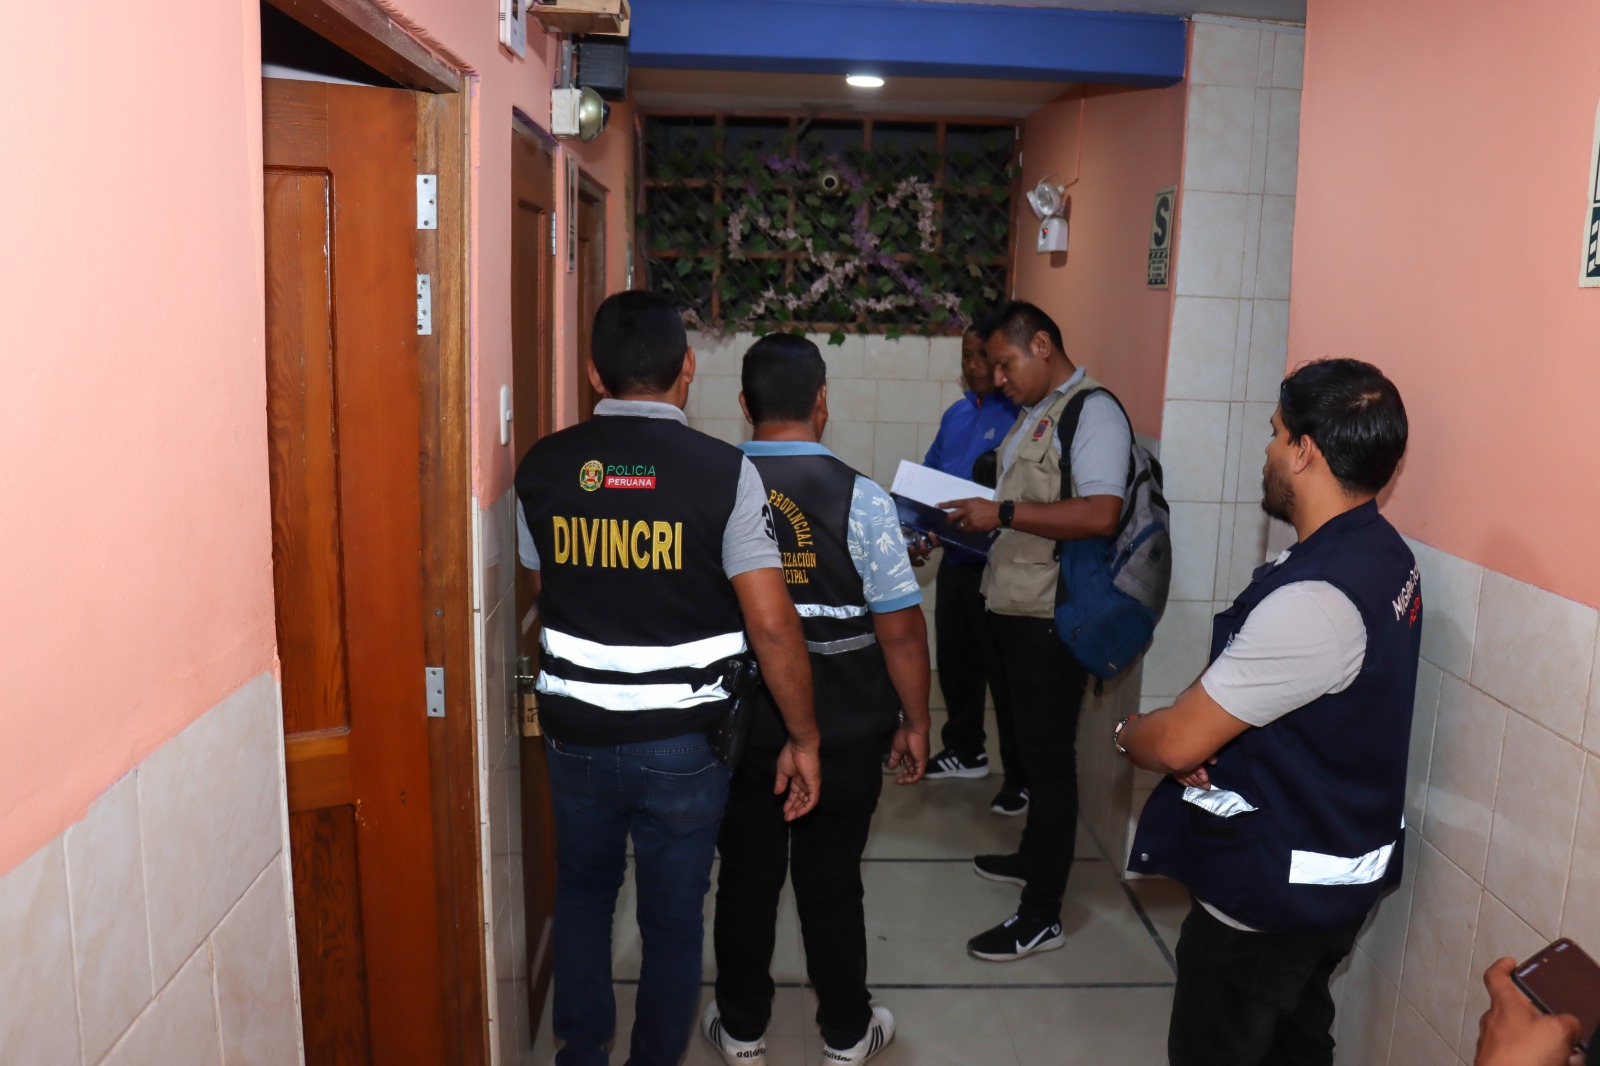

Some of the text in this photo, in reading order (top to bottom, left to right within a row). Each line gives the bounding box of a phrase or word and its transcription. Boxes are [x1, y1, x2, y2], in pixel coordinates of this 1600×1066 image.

[1153, 195, 1170, 247] S
[607, 478, 652, 487] PERUANA
[768, 489, 814, 548] PROVINCIAL
[552, 515, 683, 570] DIVINCRI
[782, 550, 817, 568] IZACIÓN
[783, 569, 809, 584] CIPAL
